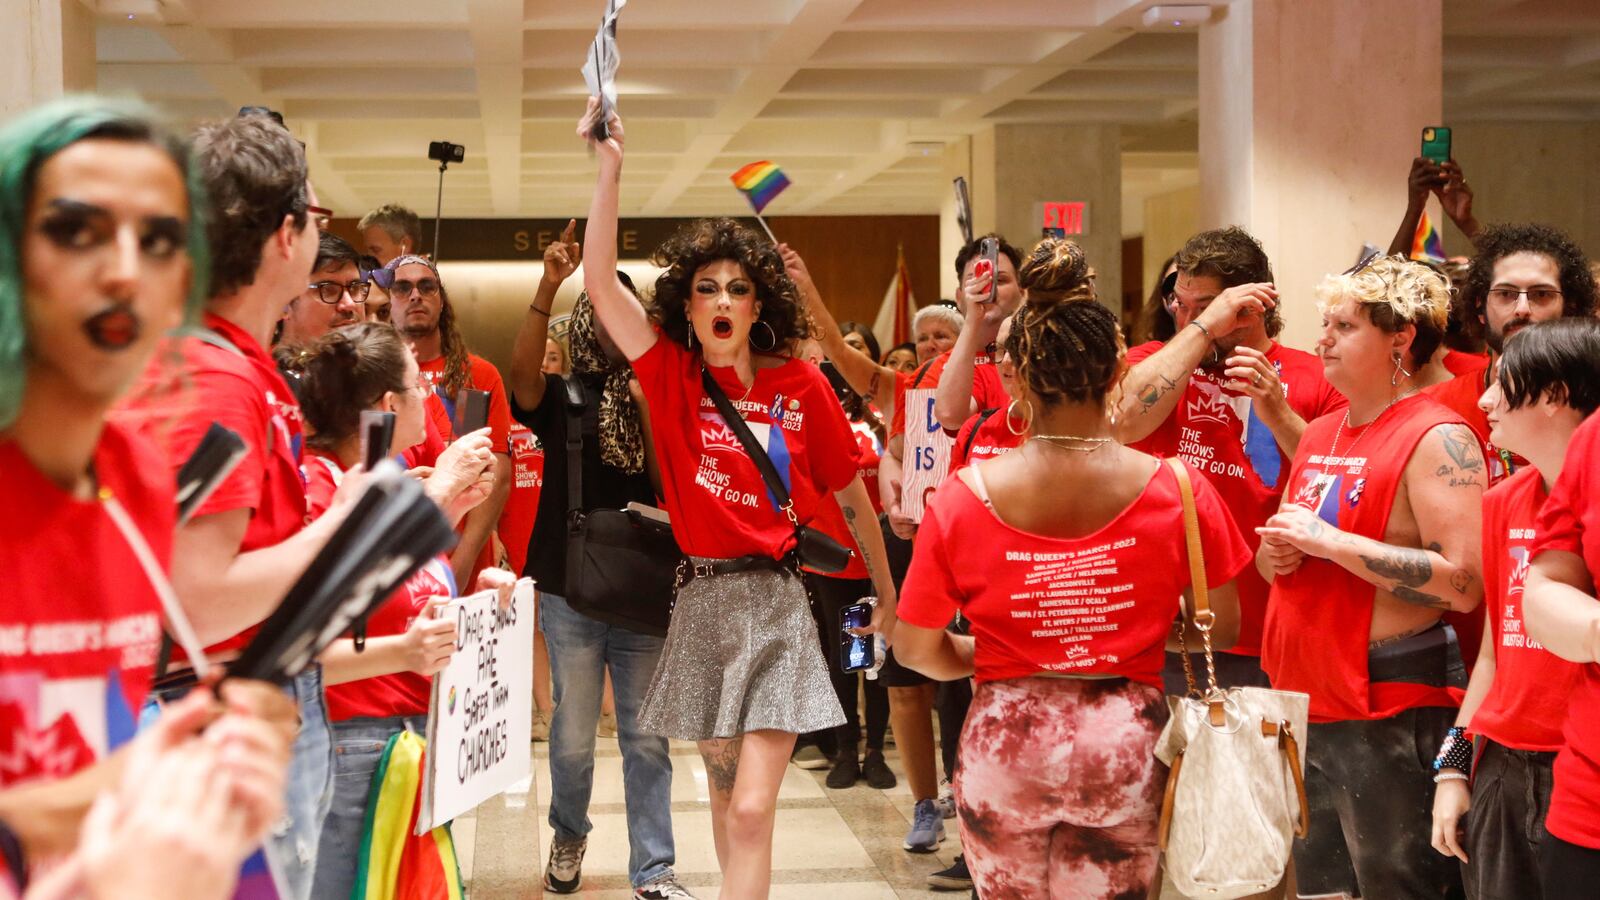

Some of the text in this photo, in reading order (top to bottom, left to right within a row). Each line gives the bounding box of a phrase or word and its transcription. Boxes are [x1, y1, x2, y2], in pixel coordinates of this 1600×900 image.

[1043, 201, 1086, 235] EXIT
[733, 400, 769, 414] UEEN'S
[784, 410, 804, 423] RCH
[782, 420, 802, 432] 2023
[1181, 426, 1203, 444] THE
[916, 446, 935, 471] IS
[1178, 440, 1215, 460] SHOWS
[515, 463, 528, 472] THE
[700, 454, 719, 470] THE
[1210, 461, 1225, 474] GO
[1227, 463, 1246, 479] ON.
[515, 471, 538, 480] SHOWS
[515, 480, 535, 488] MUST
[698, 465, 731, 487] SHOWS
[695, 473, 759, 508] MUST GO ON.
[1006, 537, 1137, 562] DRAG QUEEN'S MARCH 2023
[1048, 578, 1096, 589] JACKSONVILLE
[1046, 588, 1089, 598] LAUDERDALE
[1094, 587, 1112, 595] PALM
[1010, 610, 1032, 619] TAMPA
[1048, 607, 1090, 617] PETERSBURG
[1095, 601, 1136, 614] CLEARWATER
[1039, 599, 1080, 608] GAINESVILLE
[1085, 597, 1107, 605] OCALA
[1053, 618, 1075, 627] MYERS
[1081, 616, 1106, 624] NAPLES
[1503, 619, 1521, 632] SHOWS
[1032, 628, 1069, 638] PENSACOLA
[1074, 623, 1119, 633] TALLAHASSEE
[1503, 633, 1516, 646] MUST
[477, 638, 498, 685] ARE
[458, 718, 507, 785] CHURCHES
